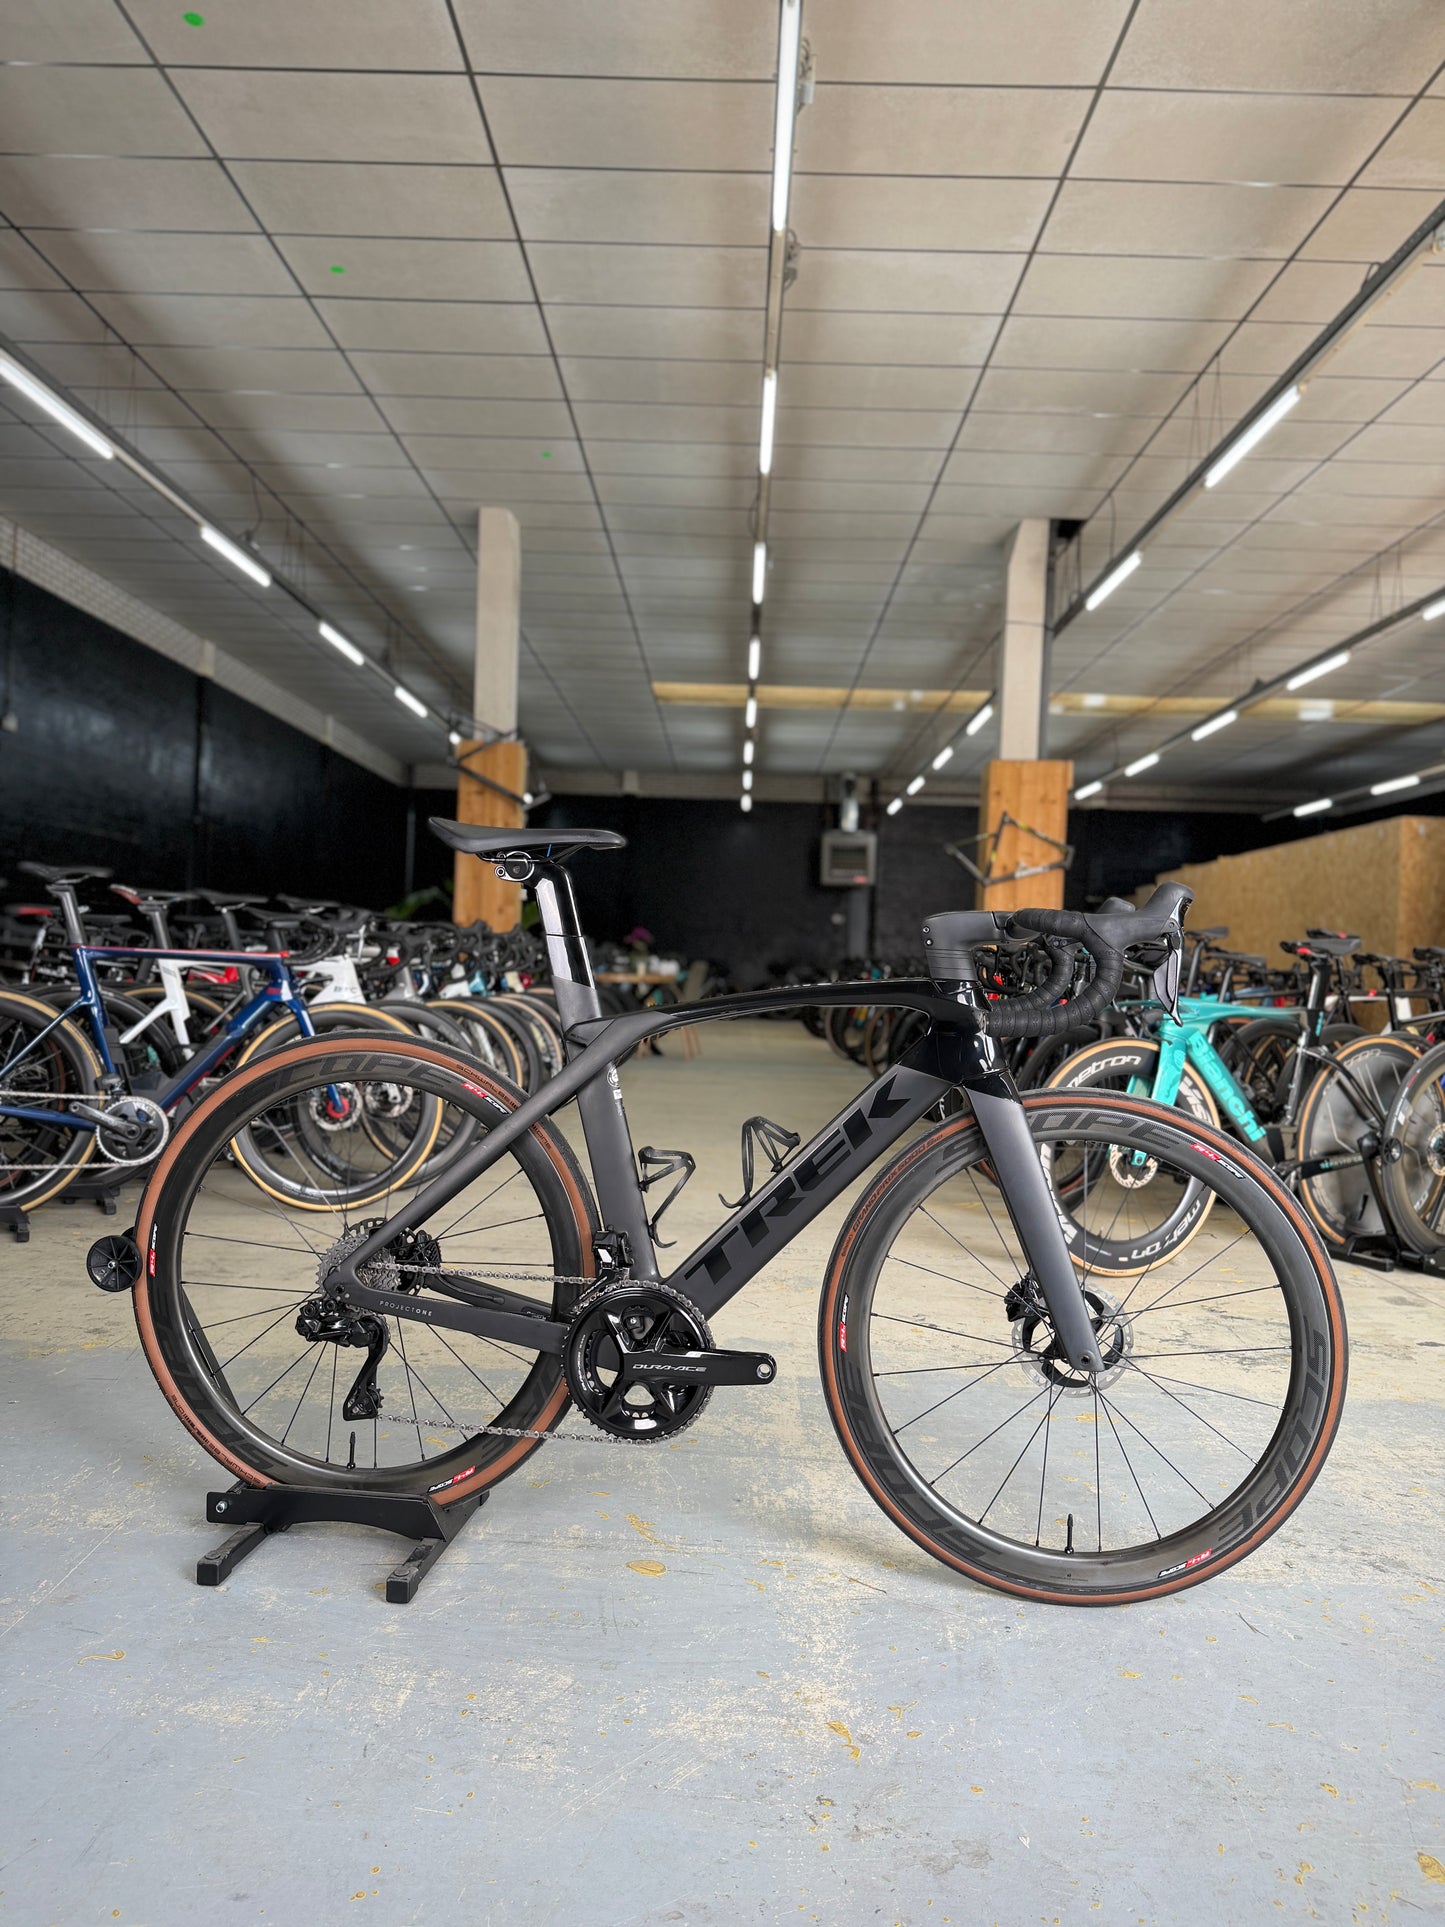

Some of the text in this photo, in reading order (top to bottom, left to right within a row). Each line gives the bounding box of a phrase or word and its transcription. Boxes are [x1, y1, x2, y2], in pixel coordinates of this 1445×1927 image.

[456, 1063, 512, 1103] SCHWALBE
[1188, 1031, 1267, 1142] Bianchi
[484, 1096, 509, 1114] SCOPE
[536, 1131, 552, 1150] ONE
[934, 1110, 1199, 1176] SOPE
[684, 1072, 912, 1286] TREK
[852, 1191, 877, 1232] GRAND
[876, 1168, 900, 1198] PRIX
[897, 1142, 926, 1172] 5000
[1216, 1159, 1244, 1178] SCOPE
[841, 1293, 849, 1324] SCOPE
[632, 1363, 708, 1373] DURA-ACE
[1216, 1313, 1328, 1553] SCOPE
[208, 1442, 262, 1485] SCHWALBE
[844, 1364, 1003, 1557] SCOPE
[428, 1478, 455, 1492] SCOPE
[1159, 1562, 1187, 1577] SCOPE
